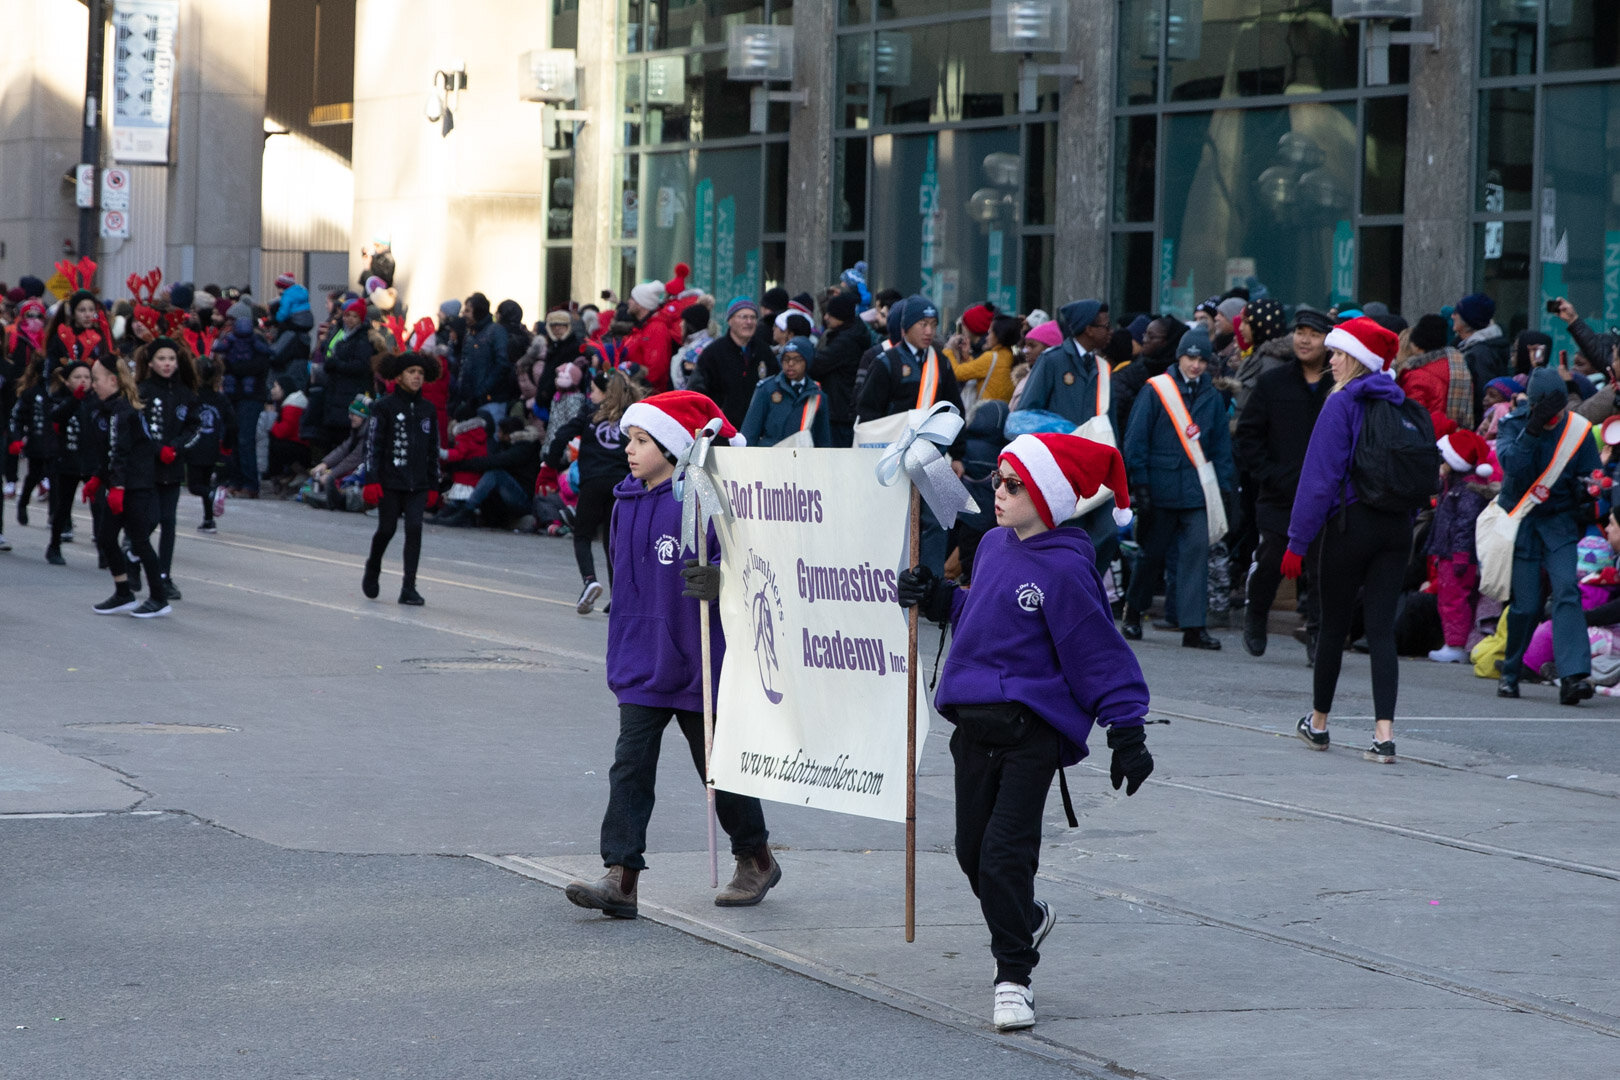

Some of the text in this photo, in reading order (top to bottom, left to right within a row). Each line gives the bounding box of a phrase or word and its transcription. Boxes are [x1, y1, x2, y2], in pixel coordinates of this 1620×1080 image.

[722, 479, 823, 524] T-Dot Tumblers
[748, 547, 784, 622] Tumblers
[796, 557, 899, 604] Gymnastics
[802, 627, 908, 676] Academy Inc.
[740, 748, 884, 796] www.tdottumblers.com
